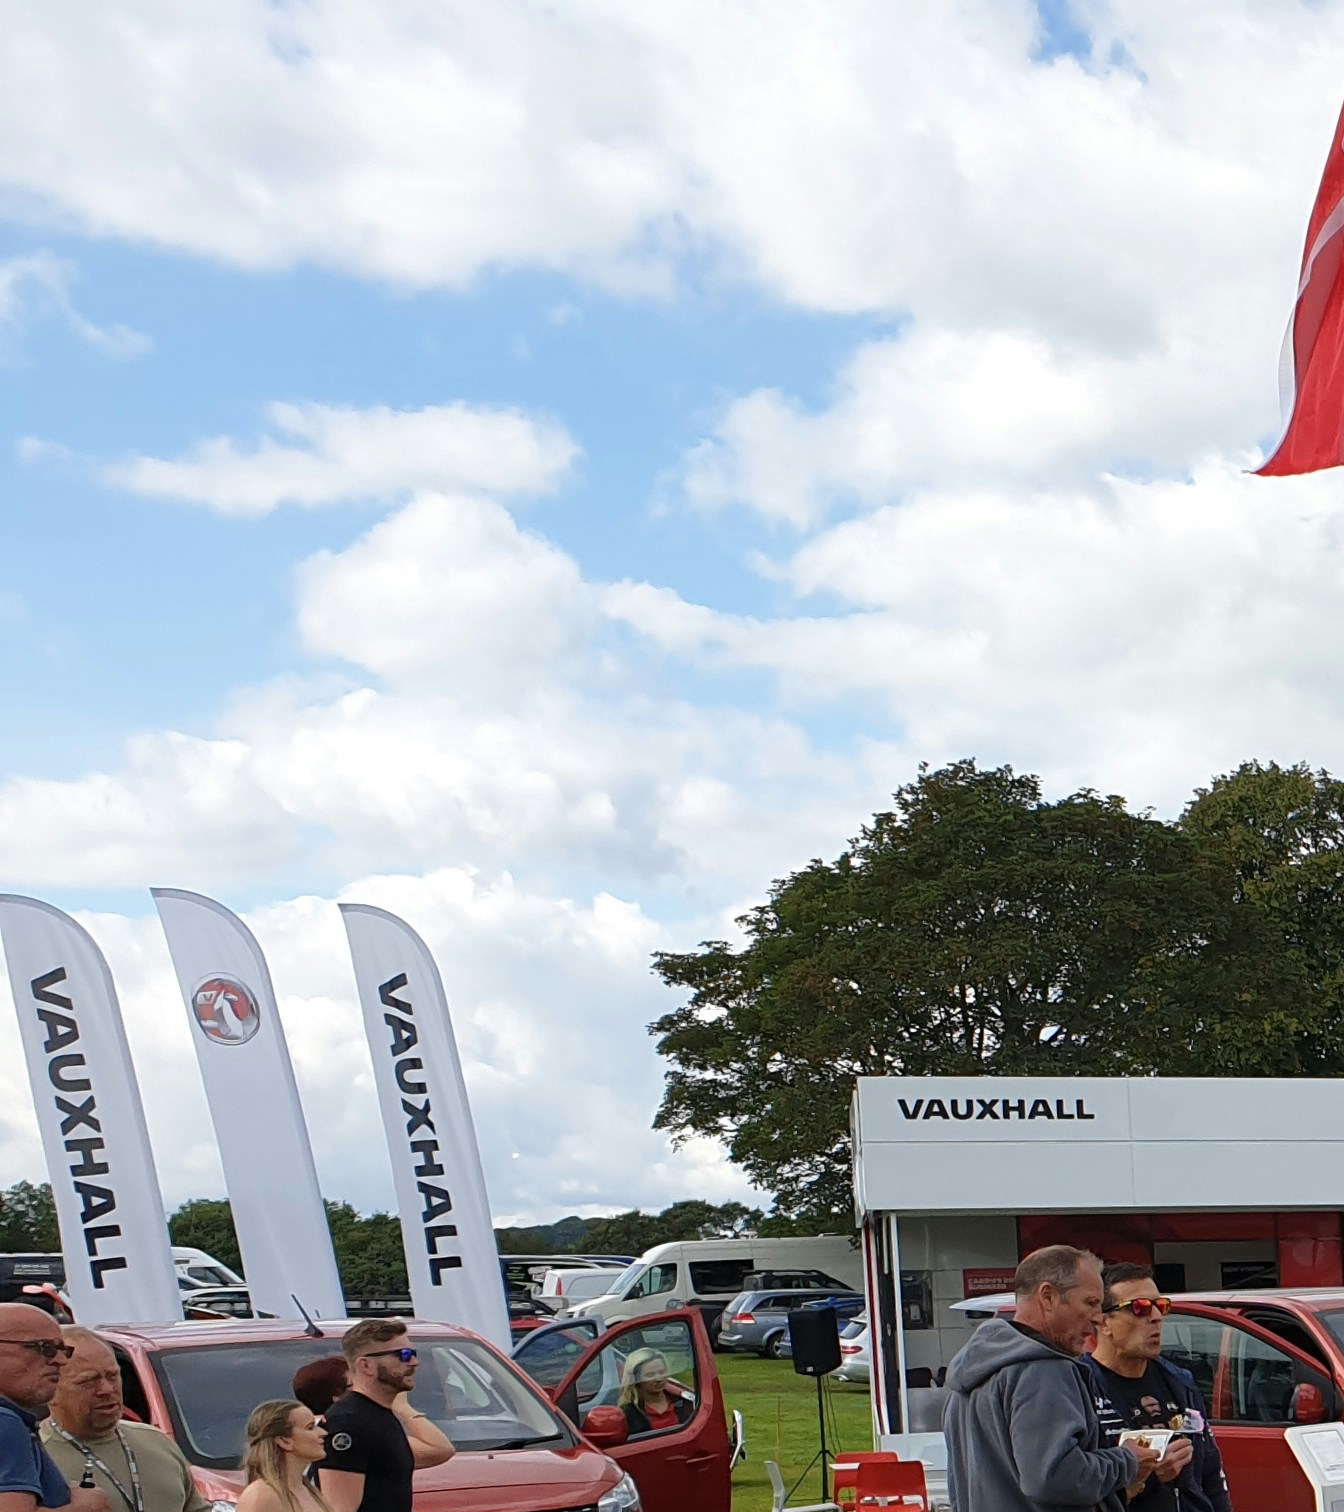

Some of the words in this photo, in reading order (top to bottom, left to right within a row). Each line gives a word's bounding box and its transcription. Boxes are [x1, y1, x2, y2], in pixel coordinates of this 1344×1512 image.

[31, 966, 128, 1290] VAUXHALL
[378, 973, 463, 1287] VAUXHALL
[897, 1099, 1096, 1121] VAUXHALL
